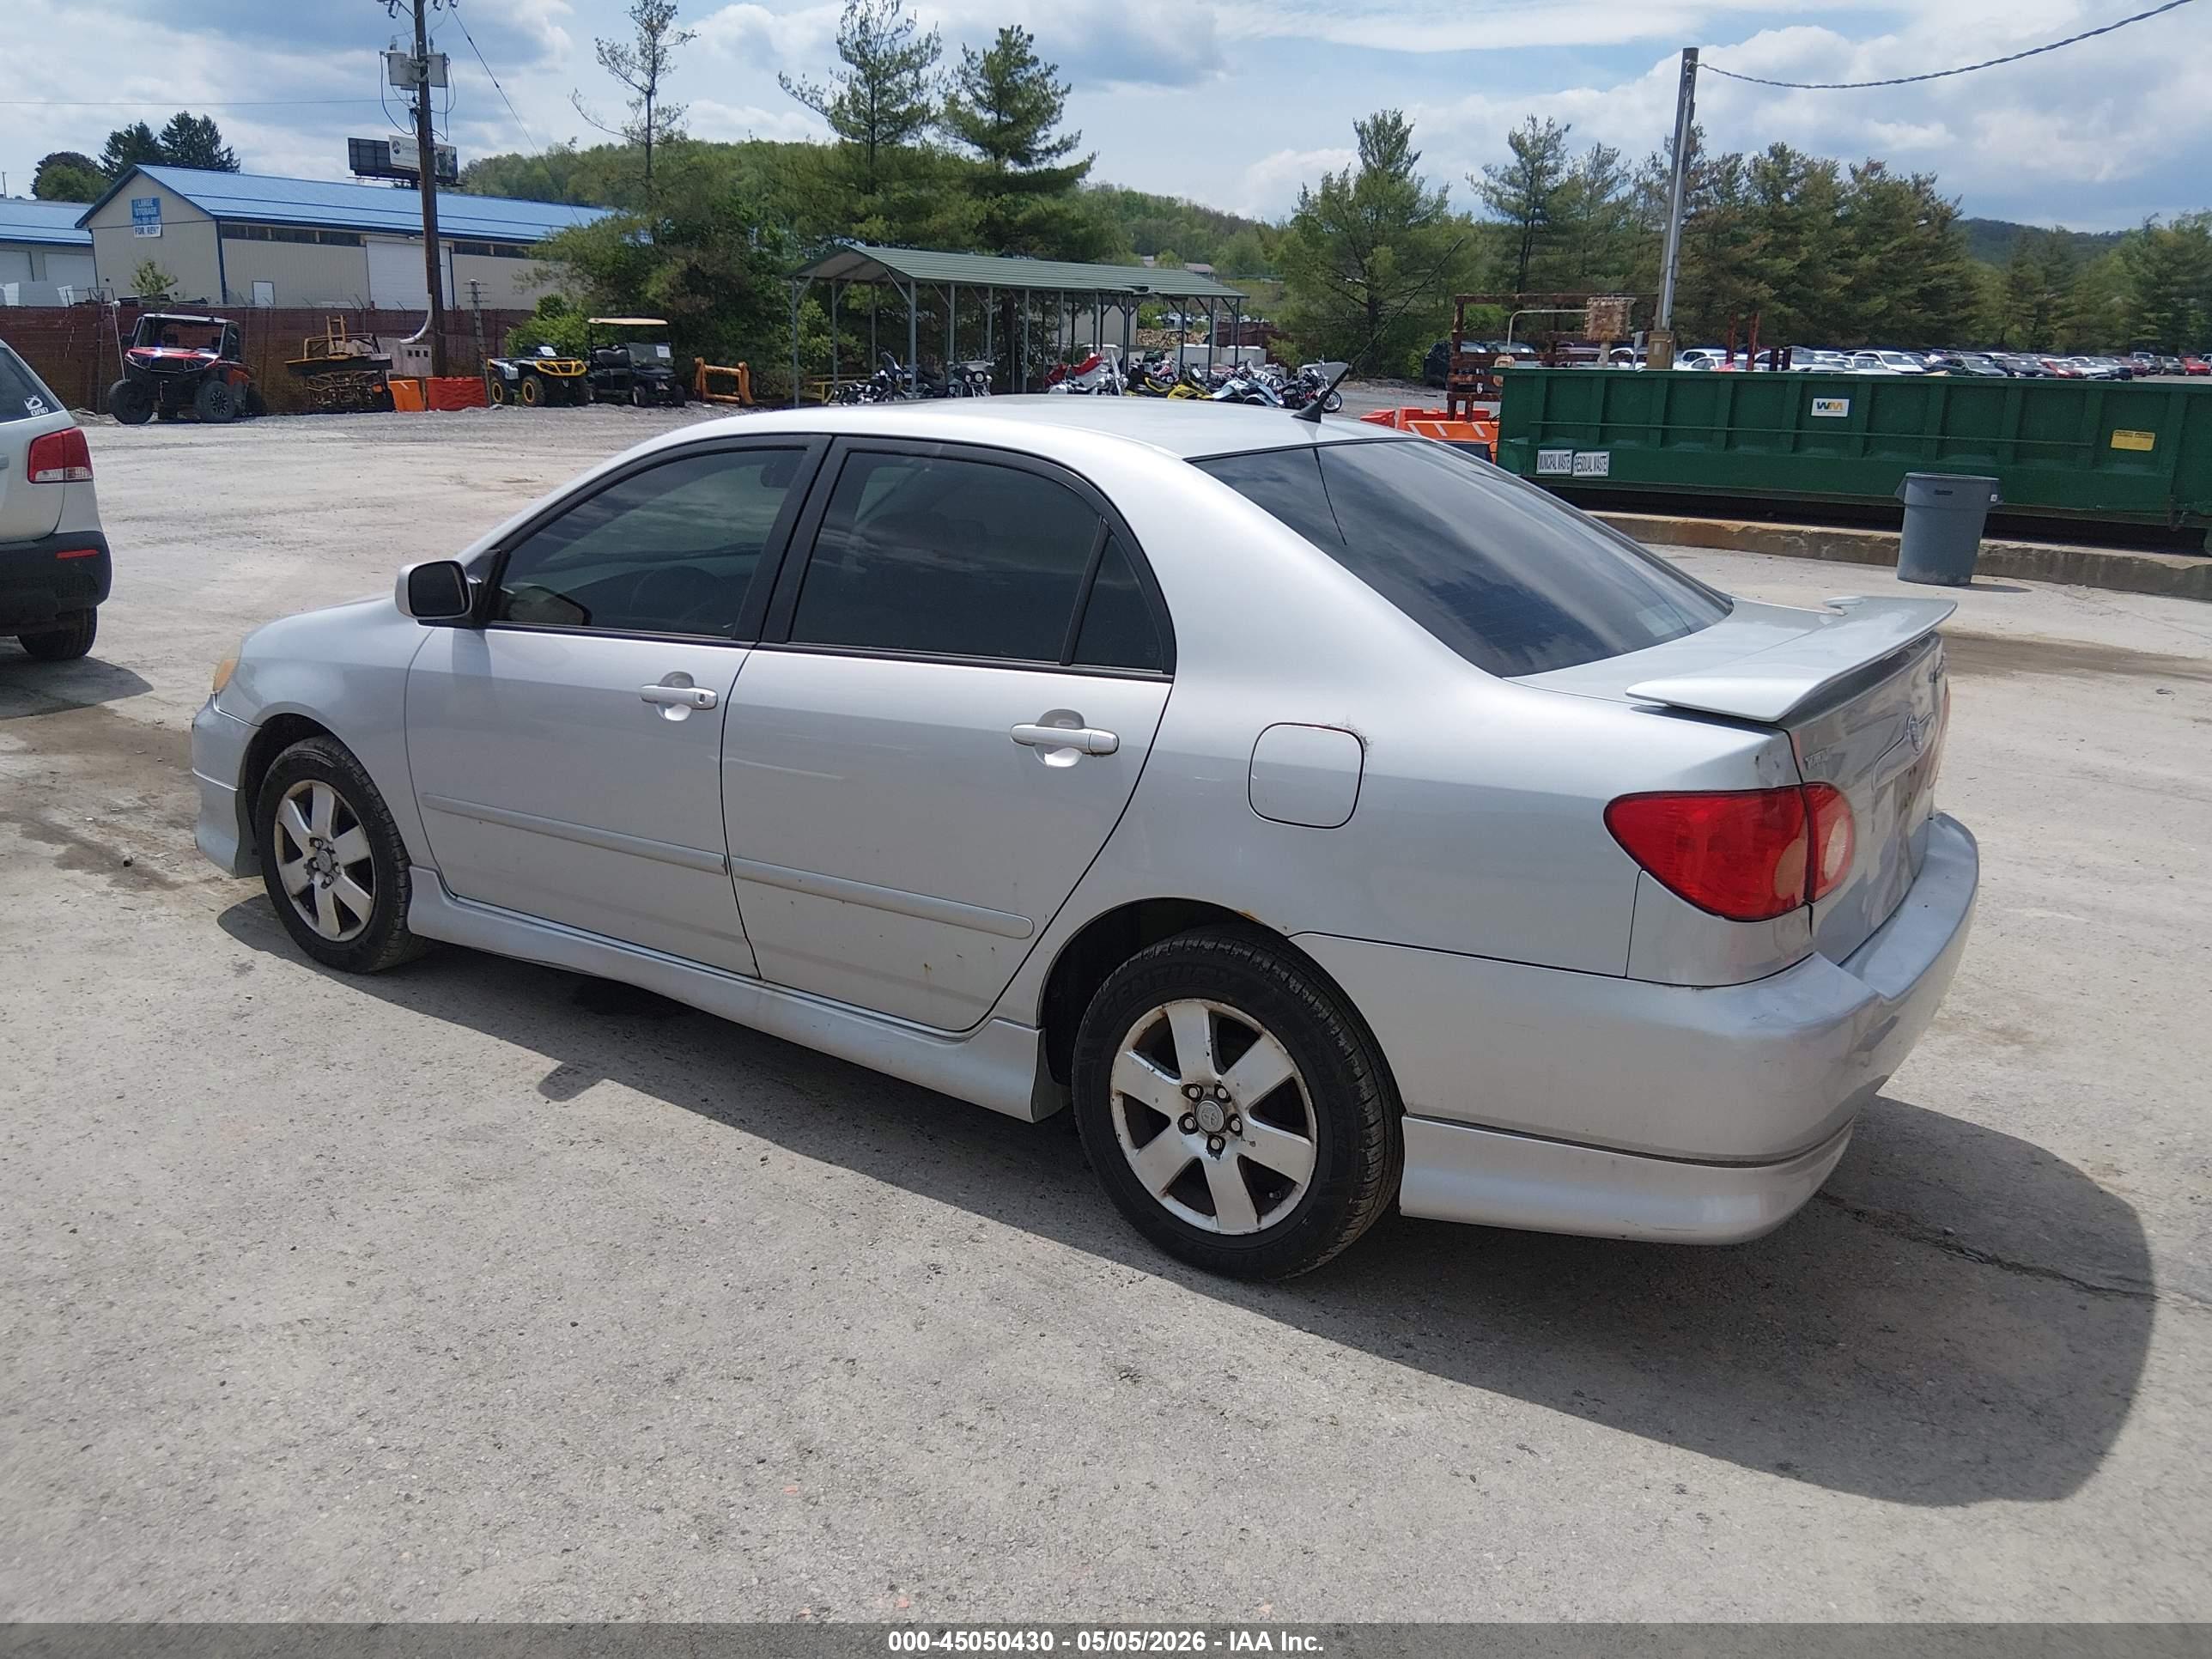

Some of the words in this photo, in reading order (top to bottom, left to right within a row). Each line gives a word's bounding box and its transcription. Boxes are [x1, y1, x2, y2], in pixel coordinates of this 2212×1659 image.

[147, 226, 159, 234] RENT
[1558, 453, 1571, 470] WASTE
[1575, 456, 1593, 472] RESIDUAL
[1594, 455, 1607, 472] WASTE
